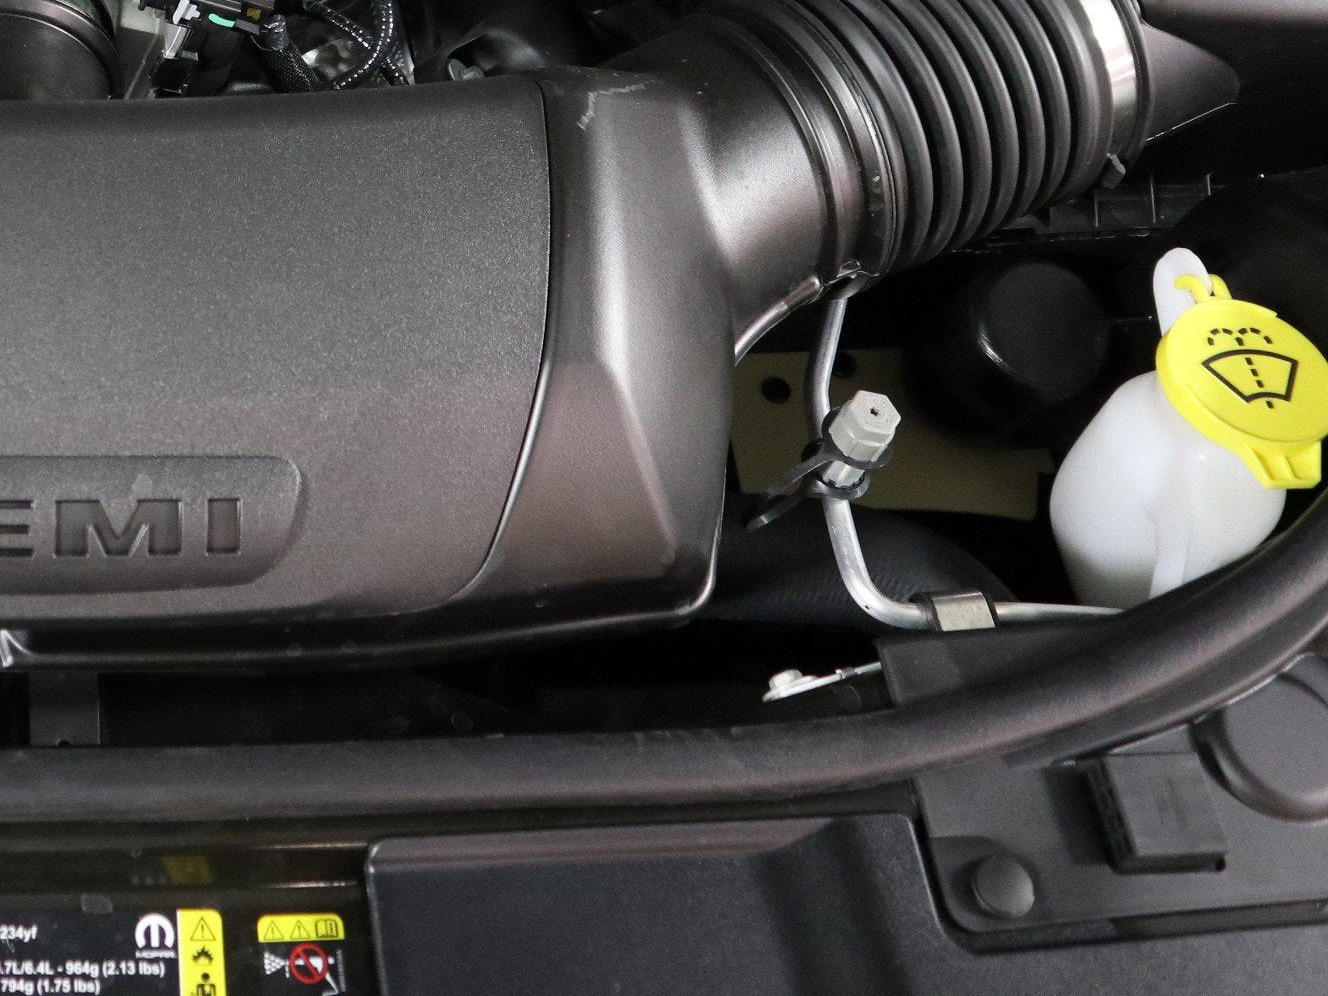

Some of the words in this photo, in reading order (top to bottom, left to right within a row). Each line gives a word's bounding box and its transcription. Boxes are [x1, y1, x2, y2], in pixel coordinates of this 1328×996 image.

[66, 961, 99, 978] 964g
[102, 961, 136, 978] (2.13
[139, 961, 165, 978] lbs)
[1, 979, 34, 995] 794g
[37, 979, 71, 994] (1.75
[74, 979, 100, 994] lbs)
